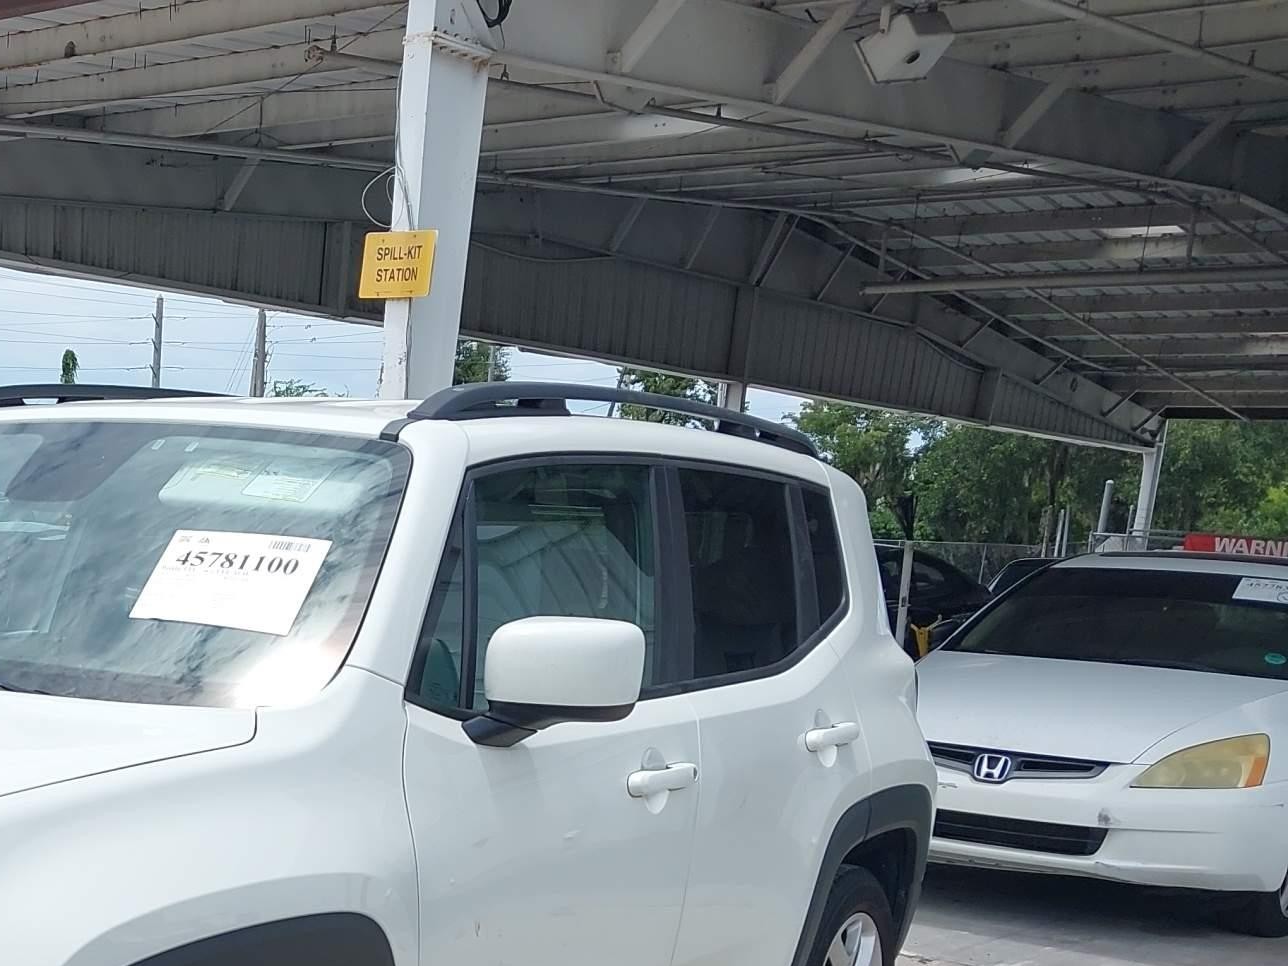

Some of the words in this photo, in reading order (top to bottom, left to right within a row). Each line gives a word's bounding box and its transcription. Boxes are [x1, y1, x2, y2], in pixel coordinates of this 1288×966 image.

[376, 245, 423, 261] SPILL-KIT
[375, 267, 418, 282] STATION
[175, 549, 299, 576] 45781100
